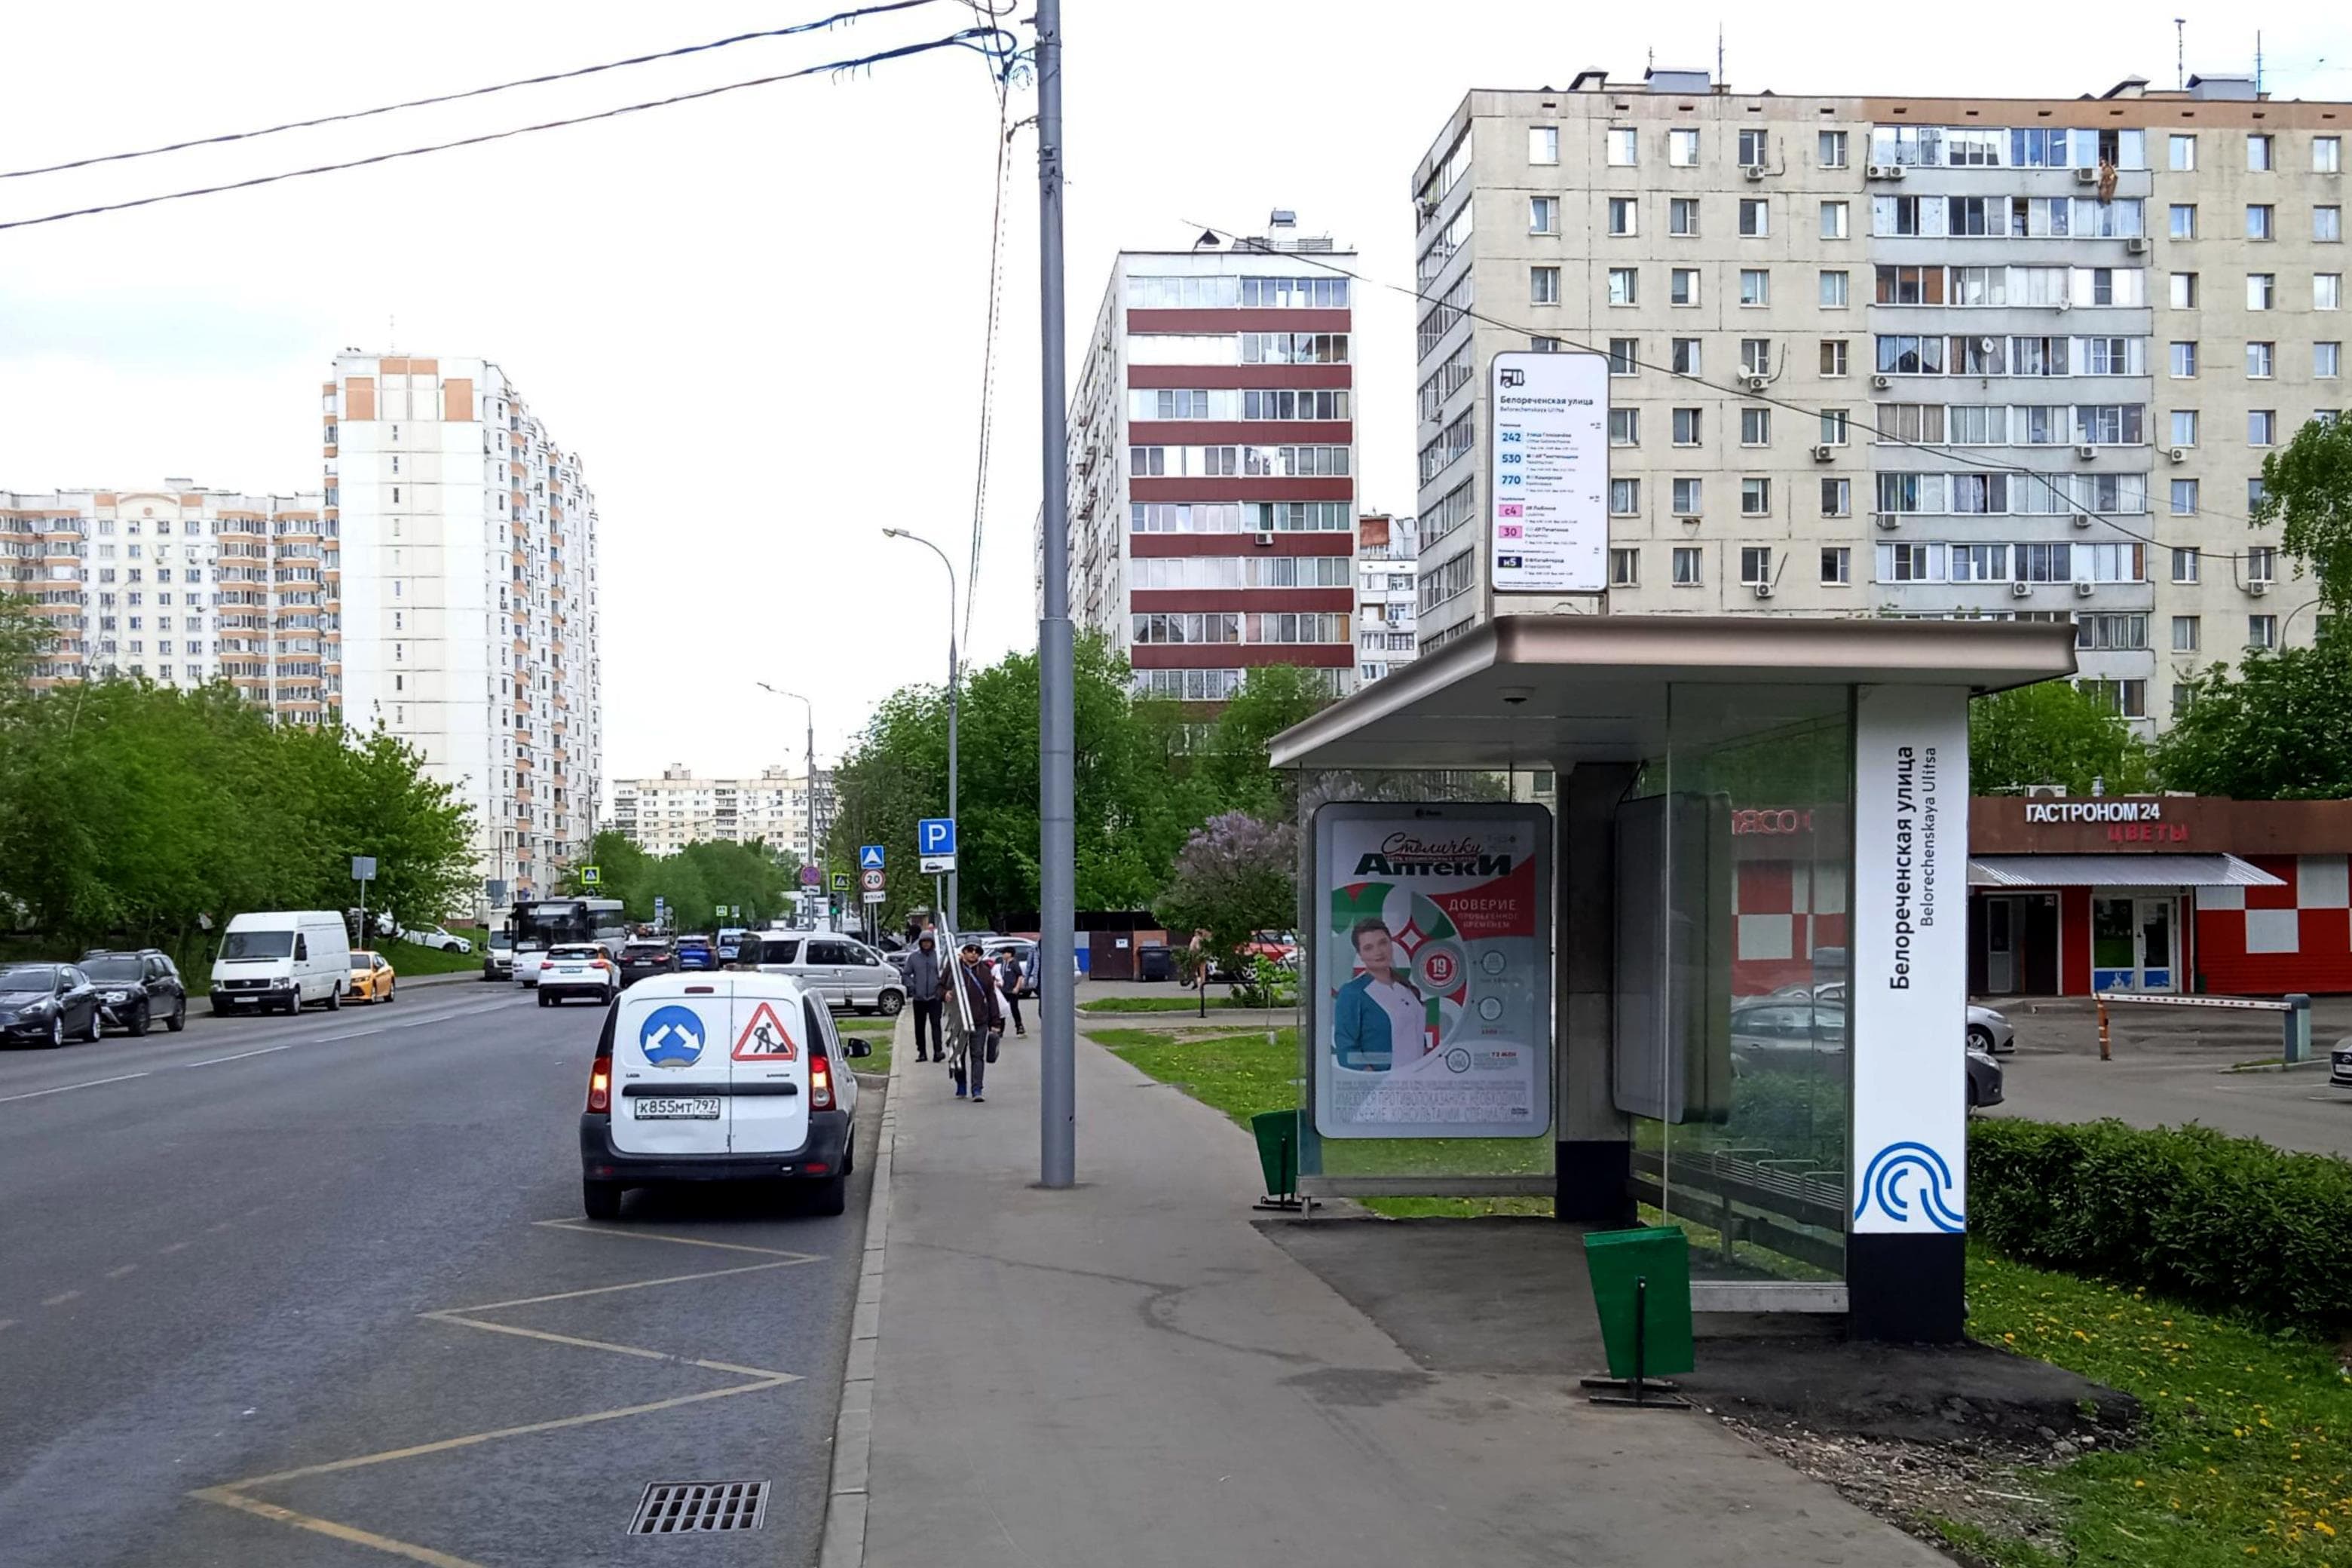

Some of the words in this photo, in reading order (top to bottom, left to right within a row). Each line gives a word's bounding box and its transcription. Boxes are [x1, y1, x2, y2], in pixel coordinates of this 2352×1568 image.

[1500, 396, 1566, 405] Белореченская
[1567, 398, 1594, 406] улица
[1502, 433, 1521, 442] 242
[1502, 454, 1521, 464] 530
[1502, 475, 1521, 485] 770
[1504, 528, 1517, 537] 30
[1921, 747, 1936, 792] Ulitsa
[1897, 746, 1916, 813] улица
[2025, 803, 2139, 822] ГАСТРОНОМ
[2139, 803, 2161, 820] 24
[928, 824, 947, 850] P
[2108, 823, 2189, 842] ЦВЕТЫ
[1381, 831, 1484, 855] Столички
[1920, 796, 1938, 926] Belorechenskaya
[867, 875, 880, 884] 20
[1448, 899, 1517, 911] ДОВЕРИЕ
[1890, 818, 1915, 990] Белореченская
[1432, 958, 1447, 973] 19
[694, 1100, 716, 1110] 797
